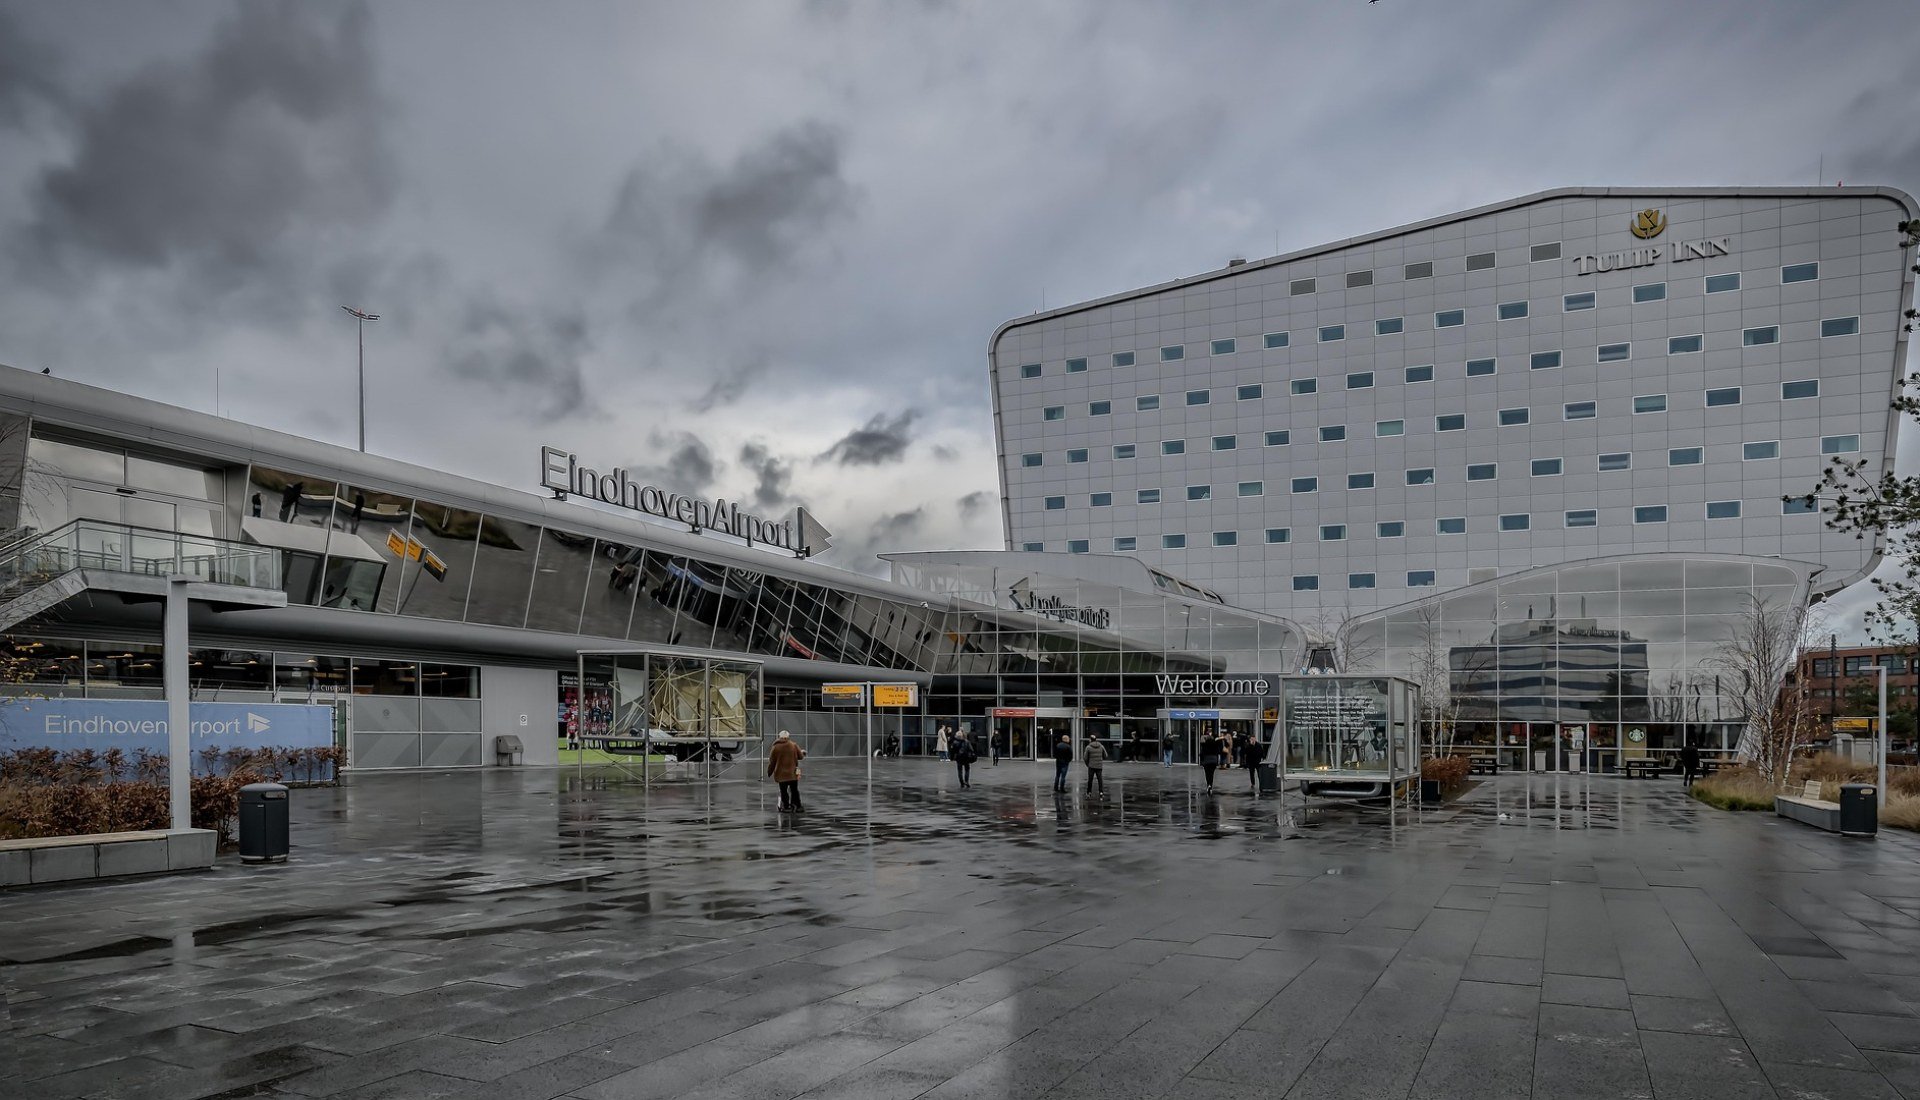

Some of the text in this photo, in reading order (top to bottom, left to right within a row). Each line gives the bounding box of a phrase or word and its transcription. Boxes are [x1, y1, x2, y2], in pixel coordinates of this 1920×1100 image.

[1574, 238, 1729, 276] TULIP INN
[541, 446, 795, 548] EindhovenAirport
[1155, 674, 1269, 695] Welcome
[45, 715, 240, 738] Eindhovenrport
